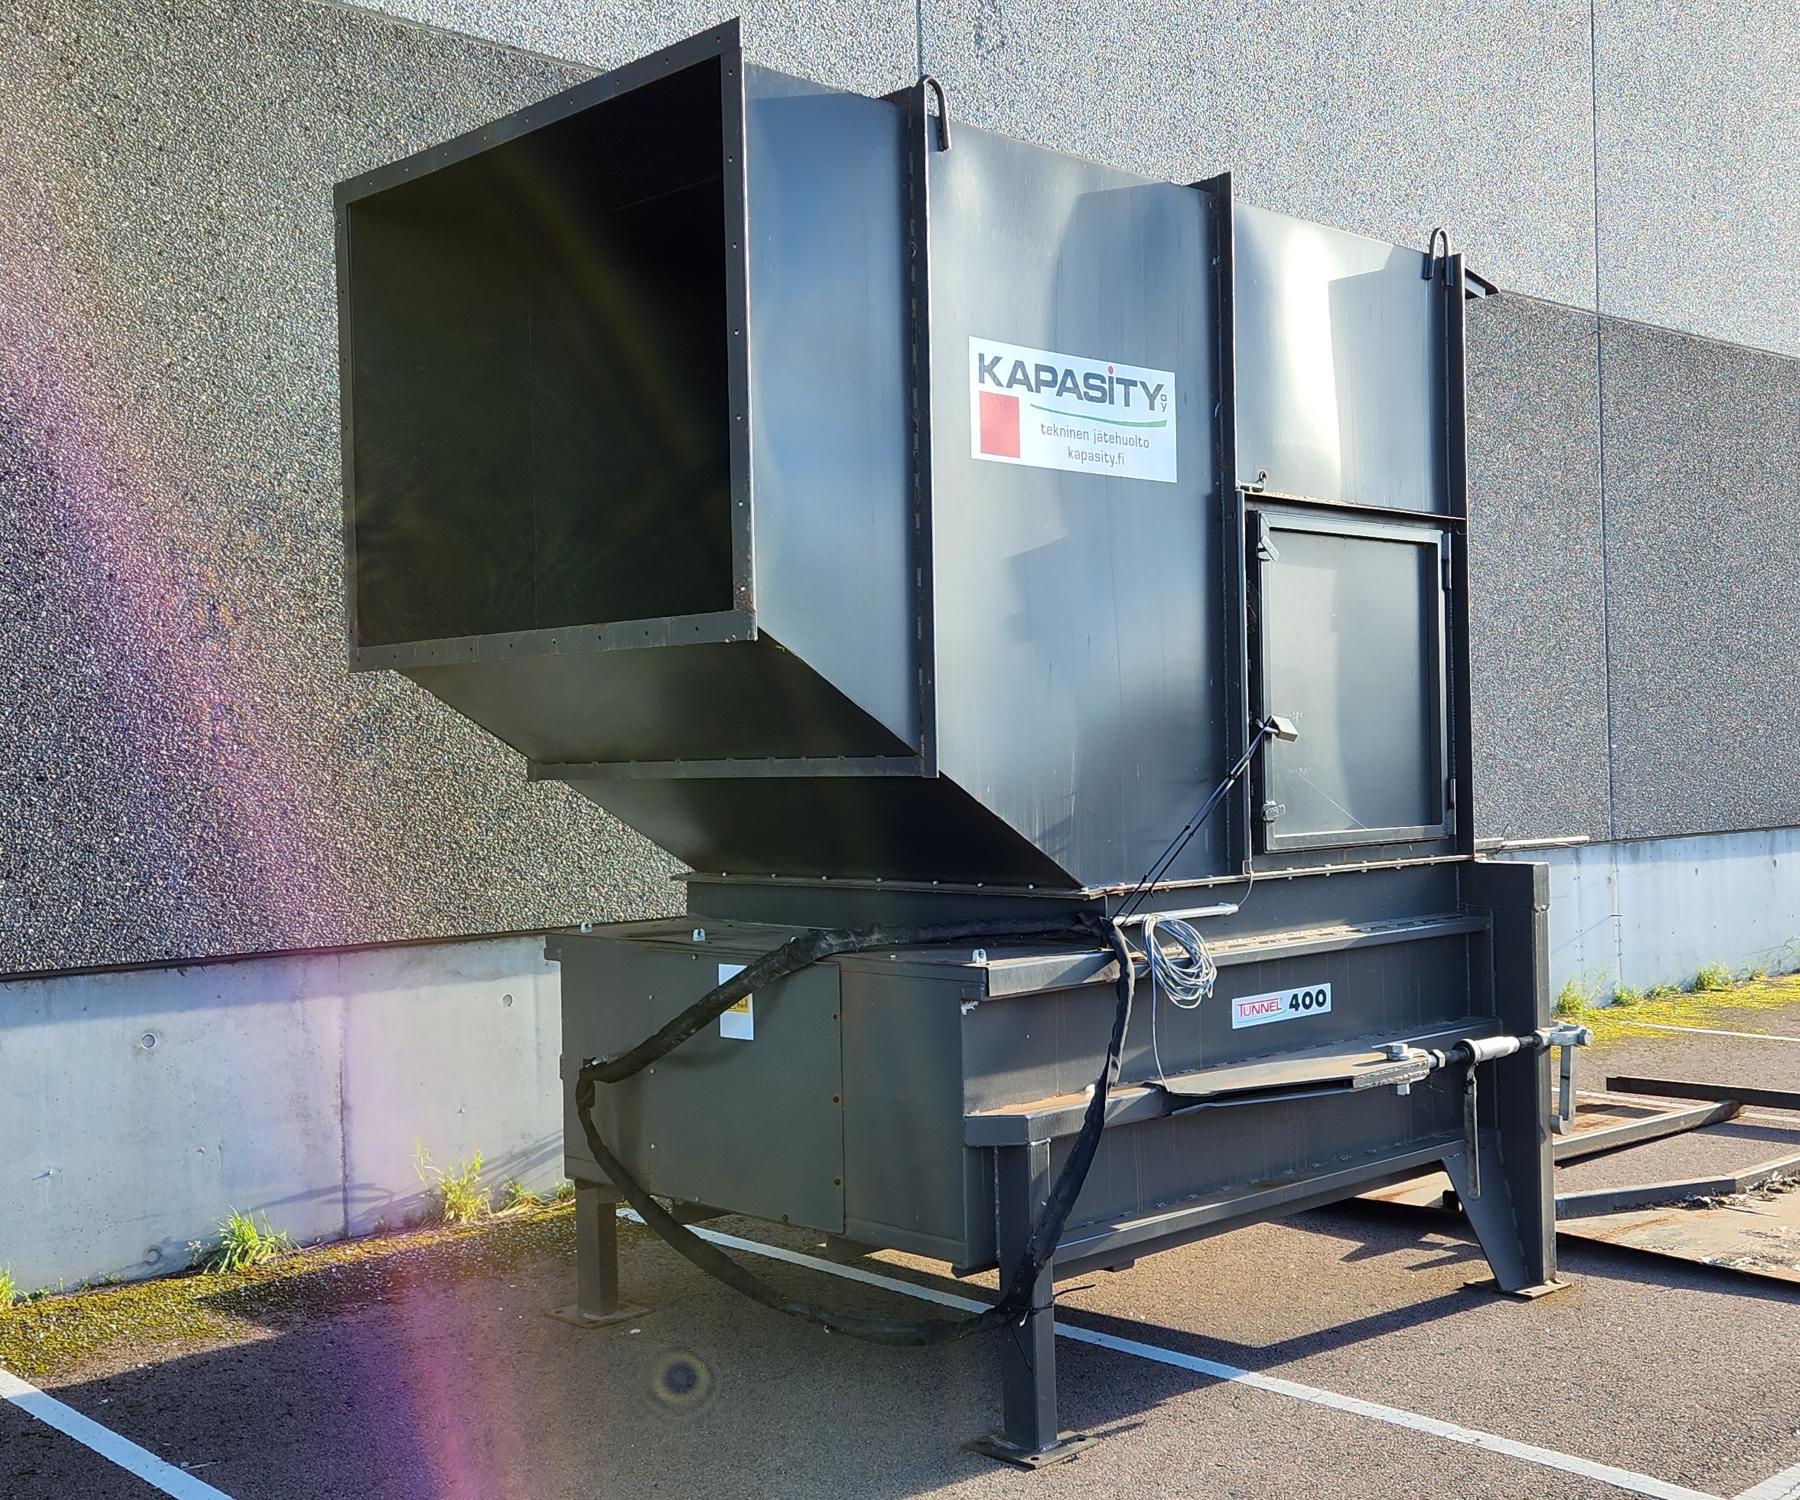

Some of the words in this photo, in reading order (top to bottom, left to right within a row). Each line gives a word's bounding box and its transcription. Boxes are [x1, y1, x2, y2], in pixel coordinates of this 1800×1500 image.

[1041, 423, 1089, 441] tekninen
[1093, 429, 1150, 449] jätehuolto
[1067, 446, 1125, 467] kapasity.fi
[1237, 998, 1282, 1016] TUNNEL
[1289, 989, 1327, 1011] 400
